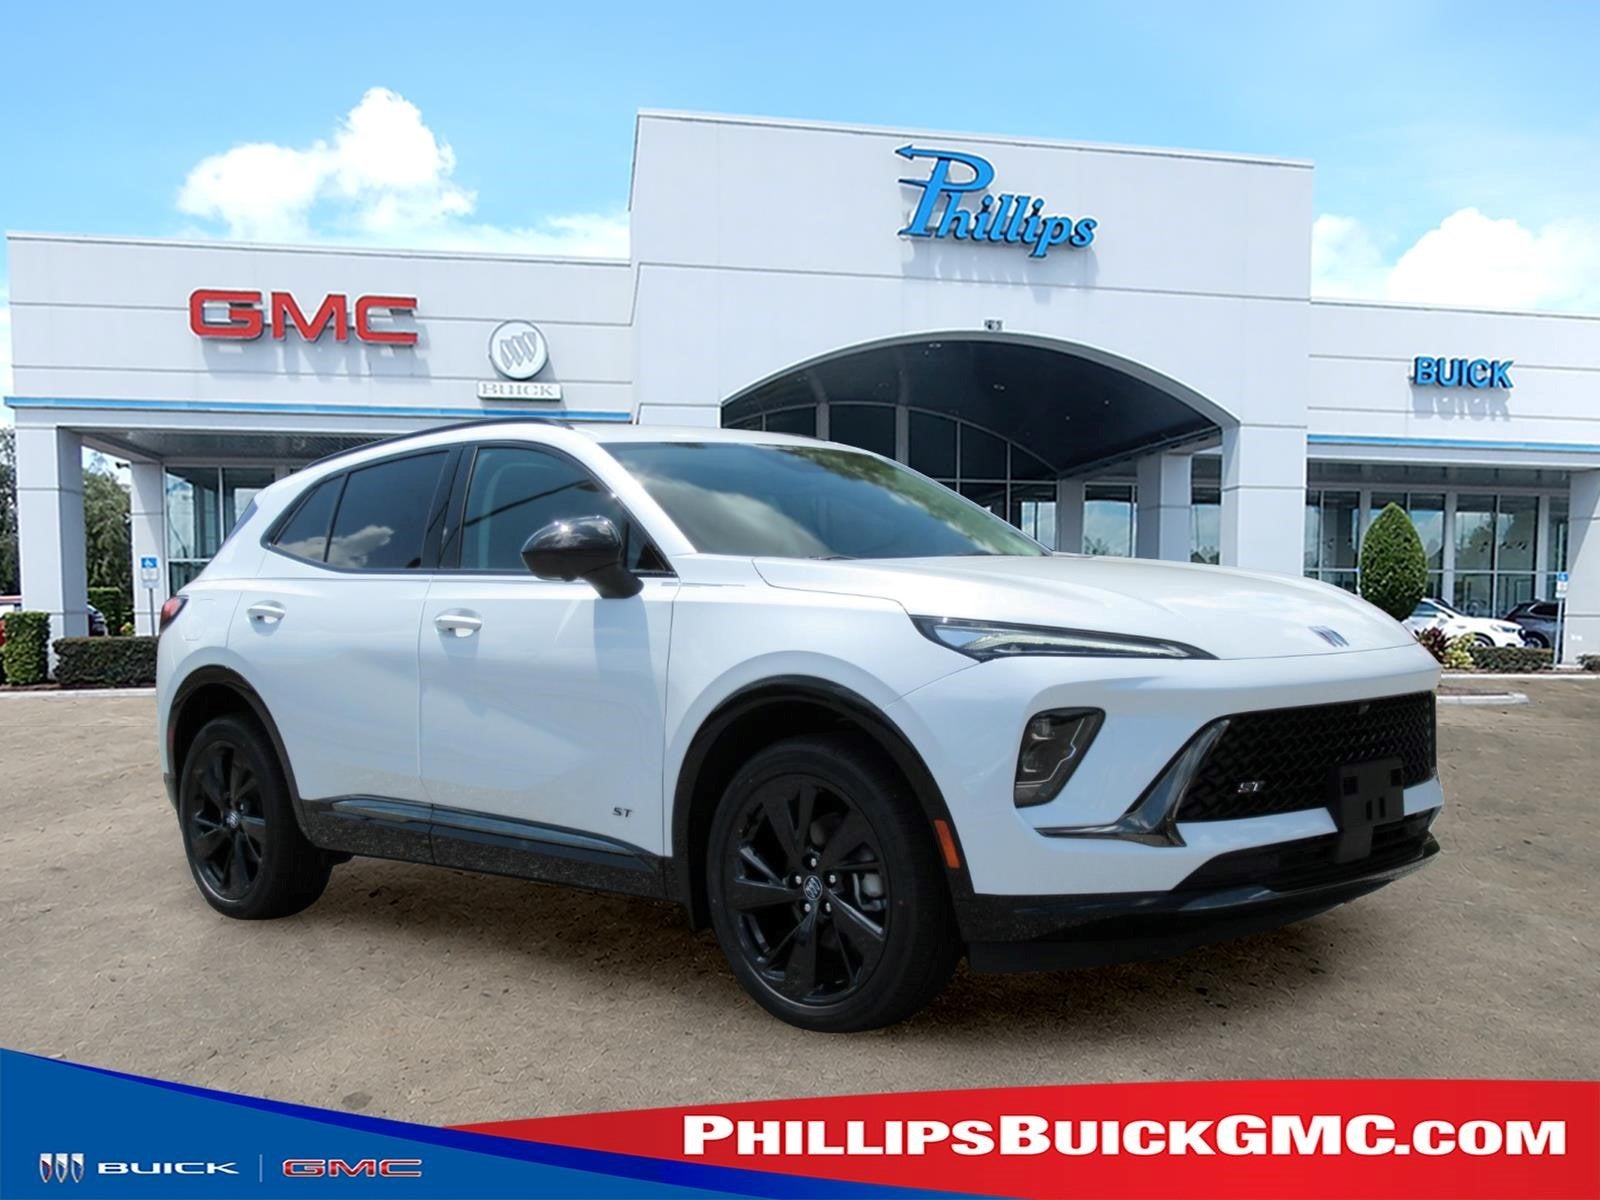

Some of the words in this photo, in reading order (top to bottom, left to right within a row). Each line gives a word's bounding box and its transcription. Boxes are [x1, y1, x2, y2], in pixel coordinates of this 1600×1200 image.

[895, 145, 1098, 258] Phillips
[189, 289, 419, 346] GMC
[1413, 356, 1514, 389] BUICK
[482, 383, 554, 396] BUICK
[612, 807, 632, 818] ST
